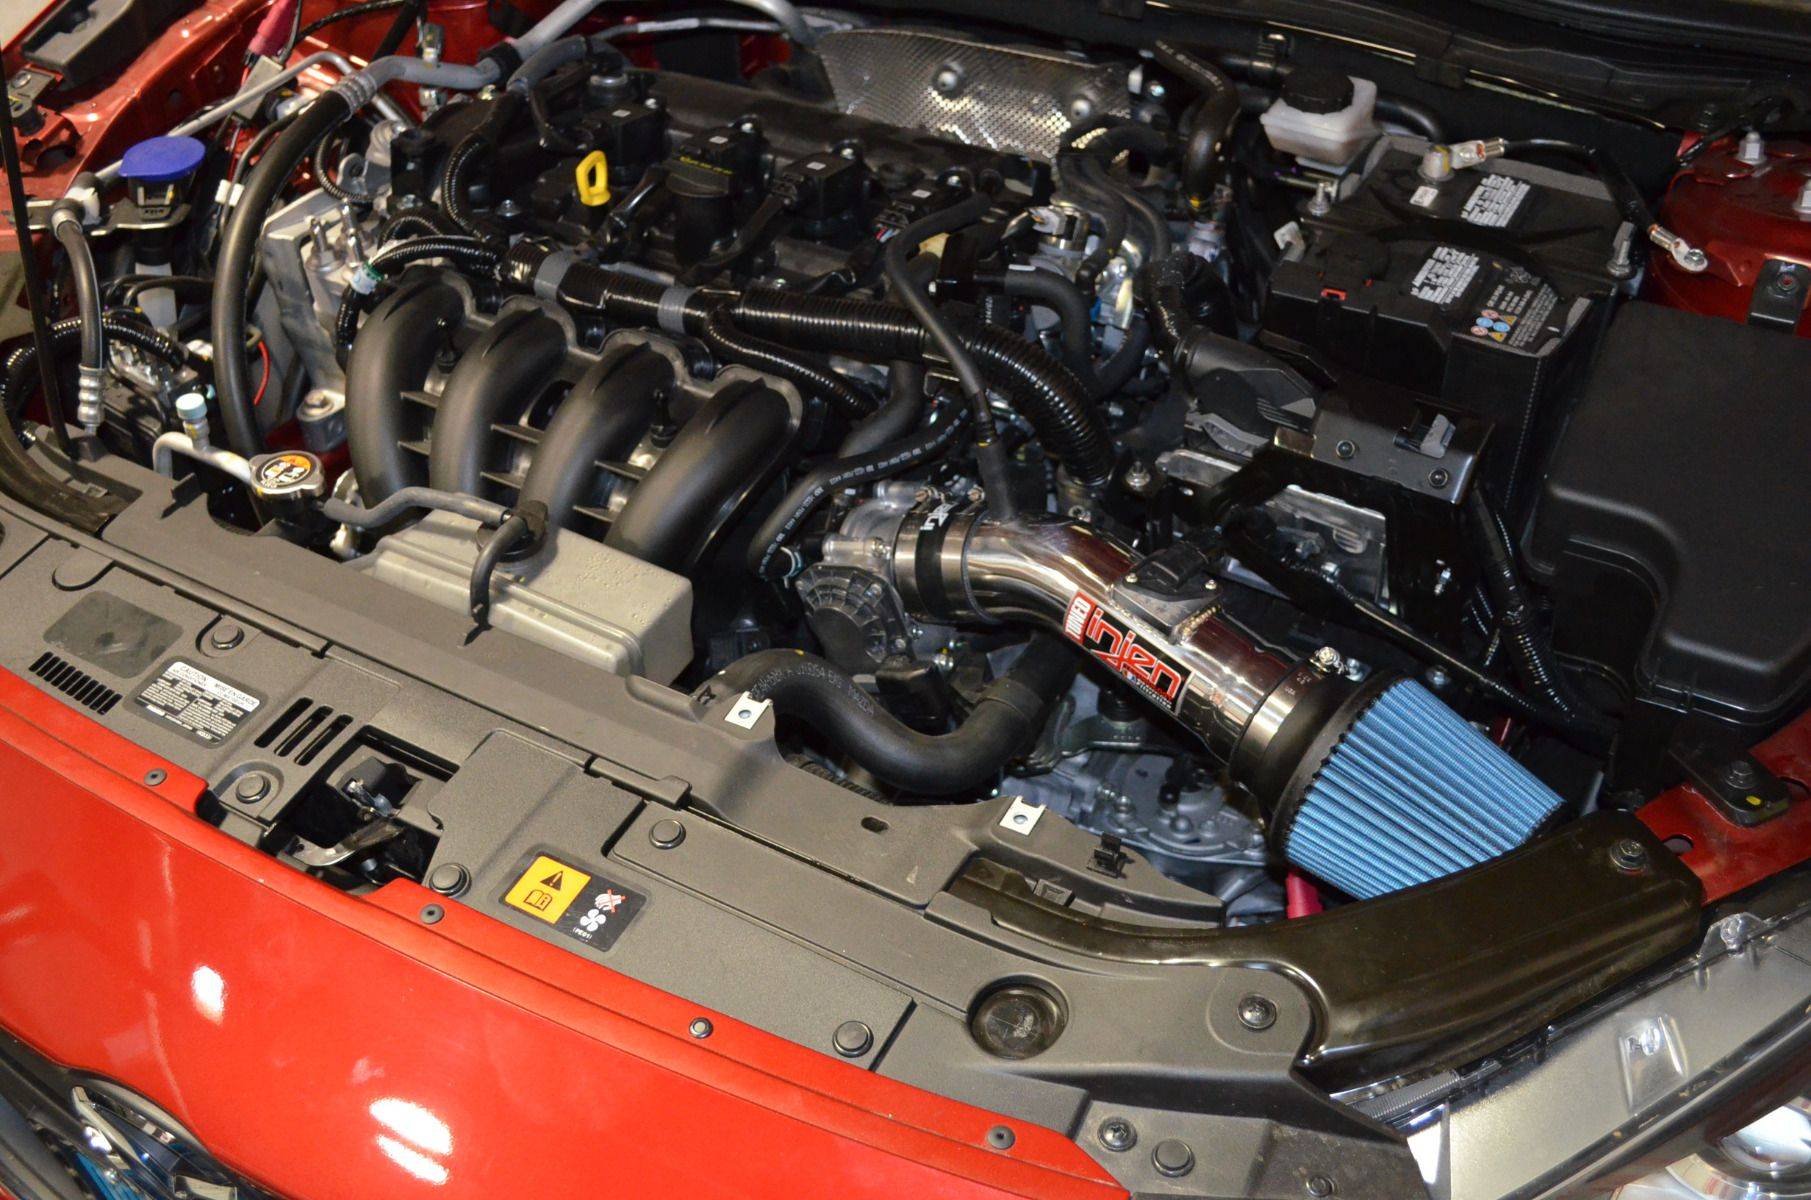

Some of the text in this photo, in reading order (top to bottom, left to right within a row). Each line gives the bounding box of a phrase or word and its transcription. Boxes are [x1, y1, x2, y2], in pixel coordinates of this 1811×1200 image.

[1066, 597, 1092, 640] TUNED
[1086, 607, 1182, 698] injen
[180, 666, 209, 683] CAUTION
